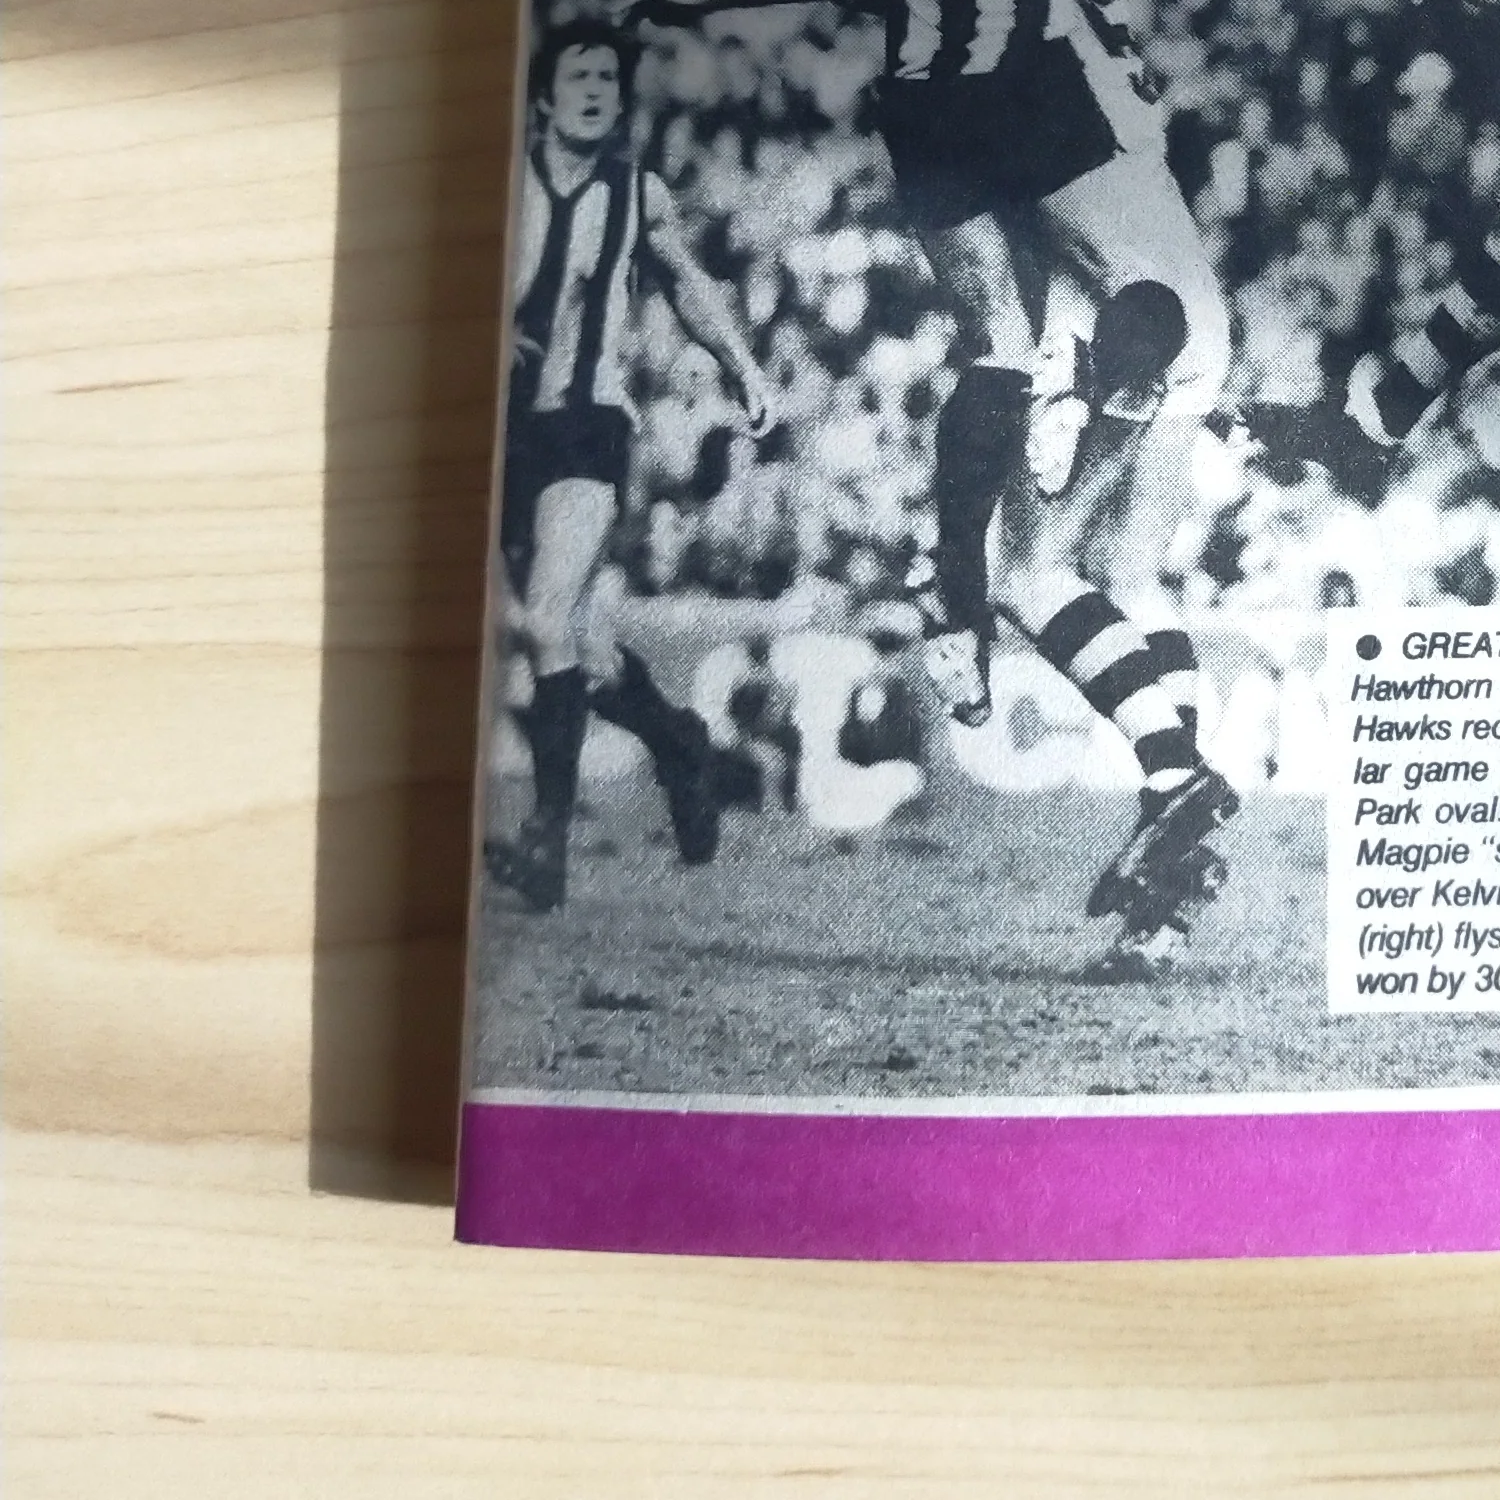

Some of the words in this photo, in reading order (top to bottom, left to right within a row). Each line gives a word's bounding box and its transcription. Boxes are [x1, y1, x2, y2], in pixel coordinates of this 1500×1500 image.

[1351, 674, 1492, 701] Hawthorn
[1353, 714, 1452, 742] Hawks
[1354, 757, 1392, 784] lar
[1404, 761, 1489, 790] game
[1355, 798, 1421, 825] Park
[1356, 838, 1470, 872] Magpie
[1356, 887, 1422, 909] over
[1359, 923, 1443, 959] (right)
[1357, 973, 1418, 994] won
[1427, 965, 1466, 1000] by
